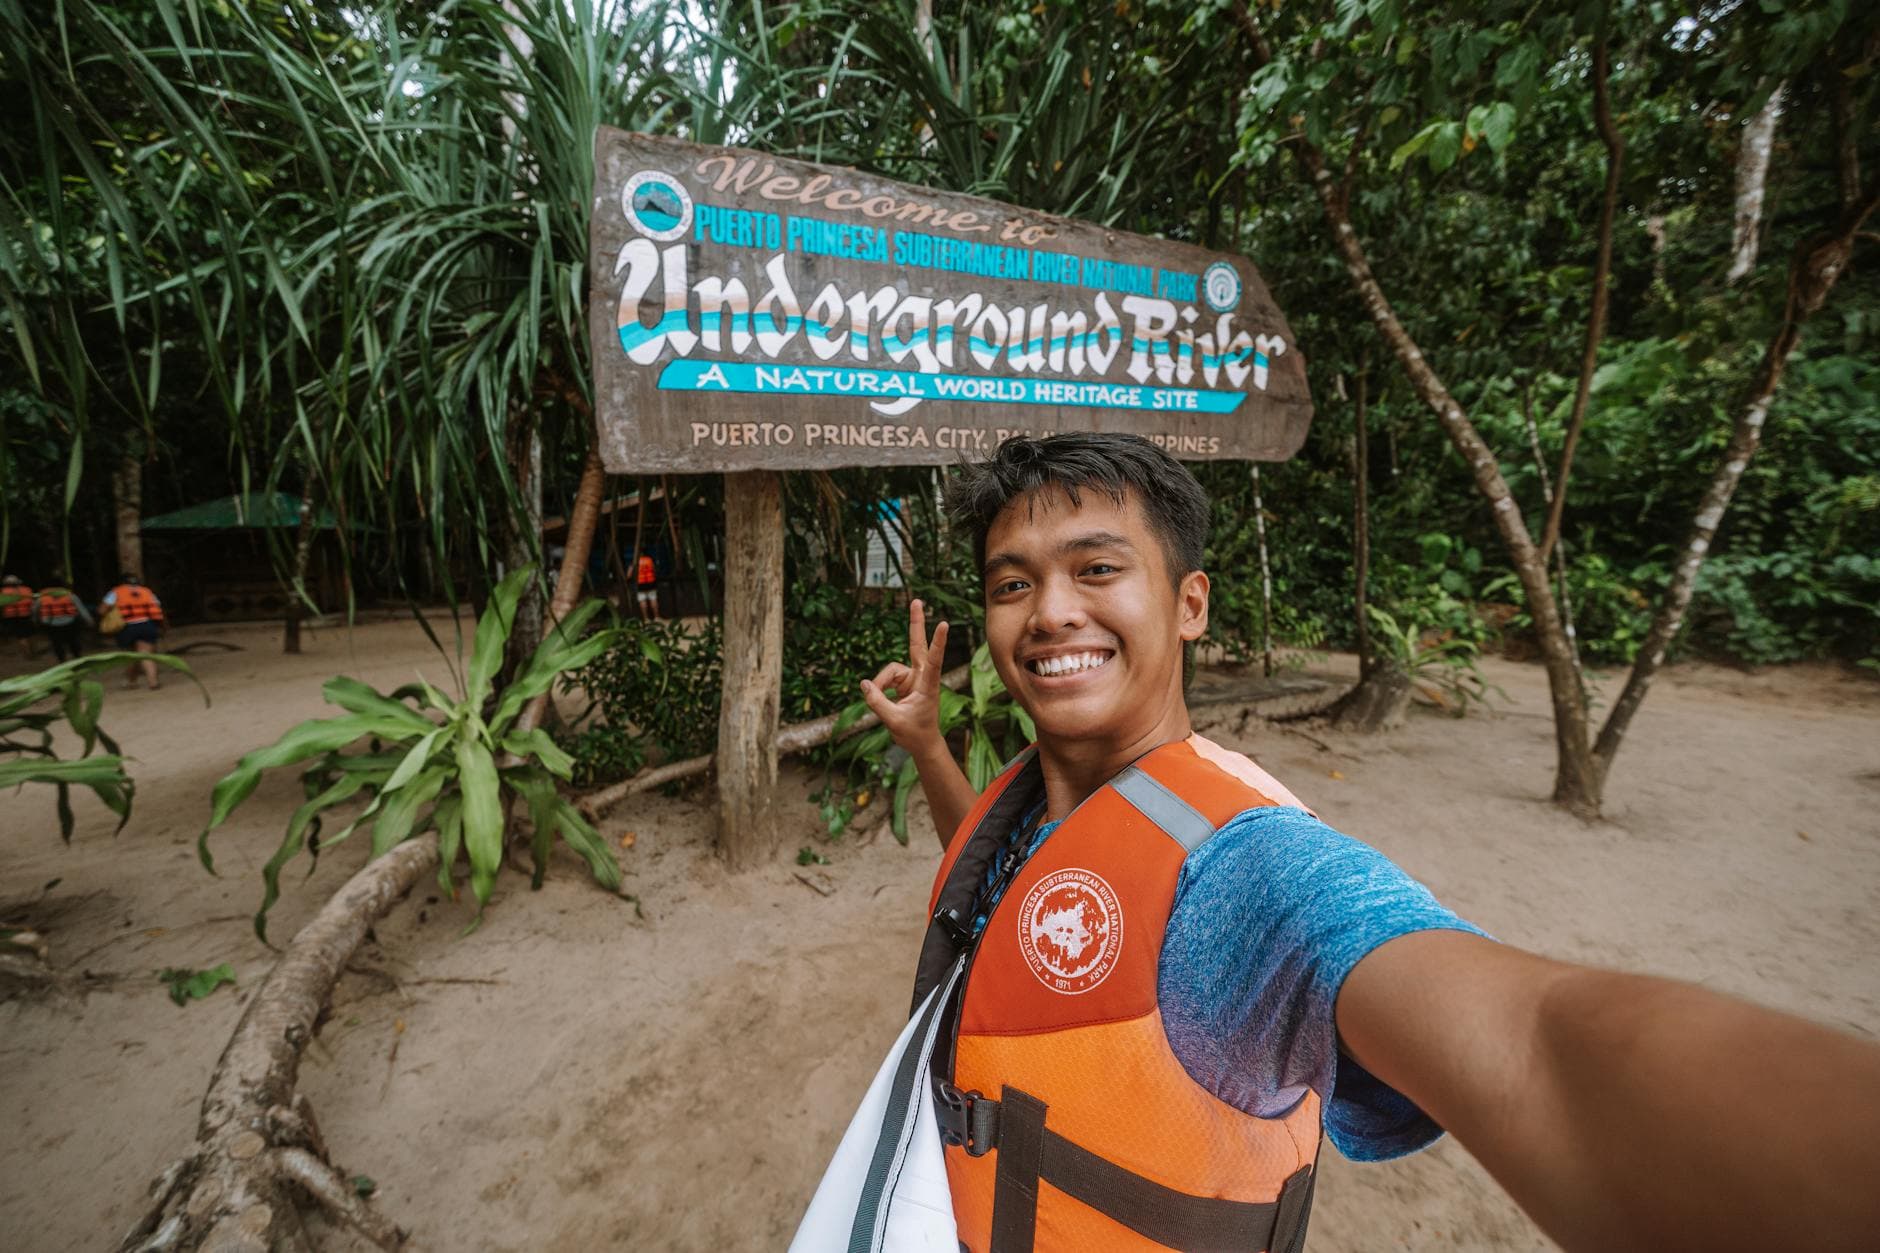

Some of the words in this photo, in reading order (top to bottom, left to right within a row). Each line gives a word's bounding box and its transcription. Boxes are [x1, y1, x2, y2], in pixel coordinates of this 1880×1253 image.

[699, 156, 991, 232] Welcome
[1000, 217, 1058, 245] to
[694, 204, 780, 250] PUERTO
[787, 215, 888, 262] PRINCESA
[894, 231, 1029, 280] SUBTERRANEAN
[1032, 249, 1080, 286] RIVER
[1082, 257, 1153, 297] NATIONAL
[1158, 268, 1198, 303] PARK
[613, 237, 1122, 416] Underground
[1122, 295, 1286, 390] River
[696, 364, 729, 389] A
[755, 367, 925, 396] NATURAL
[934, 378, 1026, 400] WORLD
[1034, 383, 1143, 407] HERITAGE
[1152, 390, 1199, 409] SITE
[690, 423, 794, 447] PUERTO
[805, 424, 929, 449] PRINCESA
[1039, 873, 1101, 893] SUBTERRANEAN
[1098, 886, 1115, 912] RIVER
[1022, 891, 1041, 934] PRINCESA
[1021, 936, 1043, 973] PUERTO
[1105, 912, 1118, 963] NATIONAL
[1055, 979, 1071, 990] 1971
[1089, 961, 1109, 983] PARK
